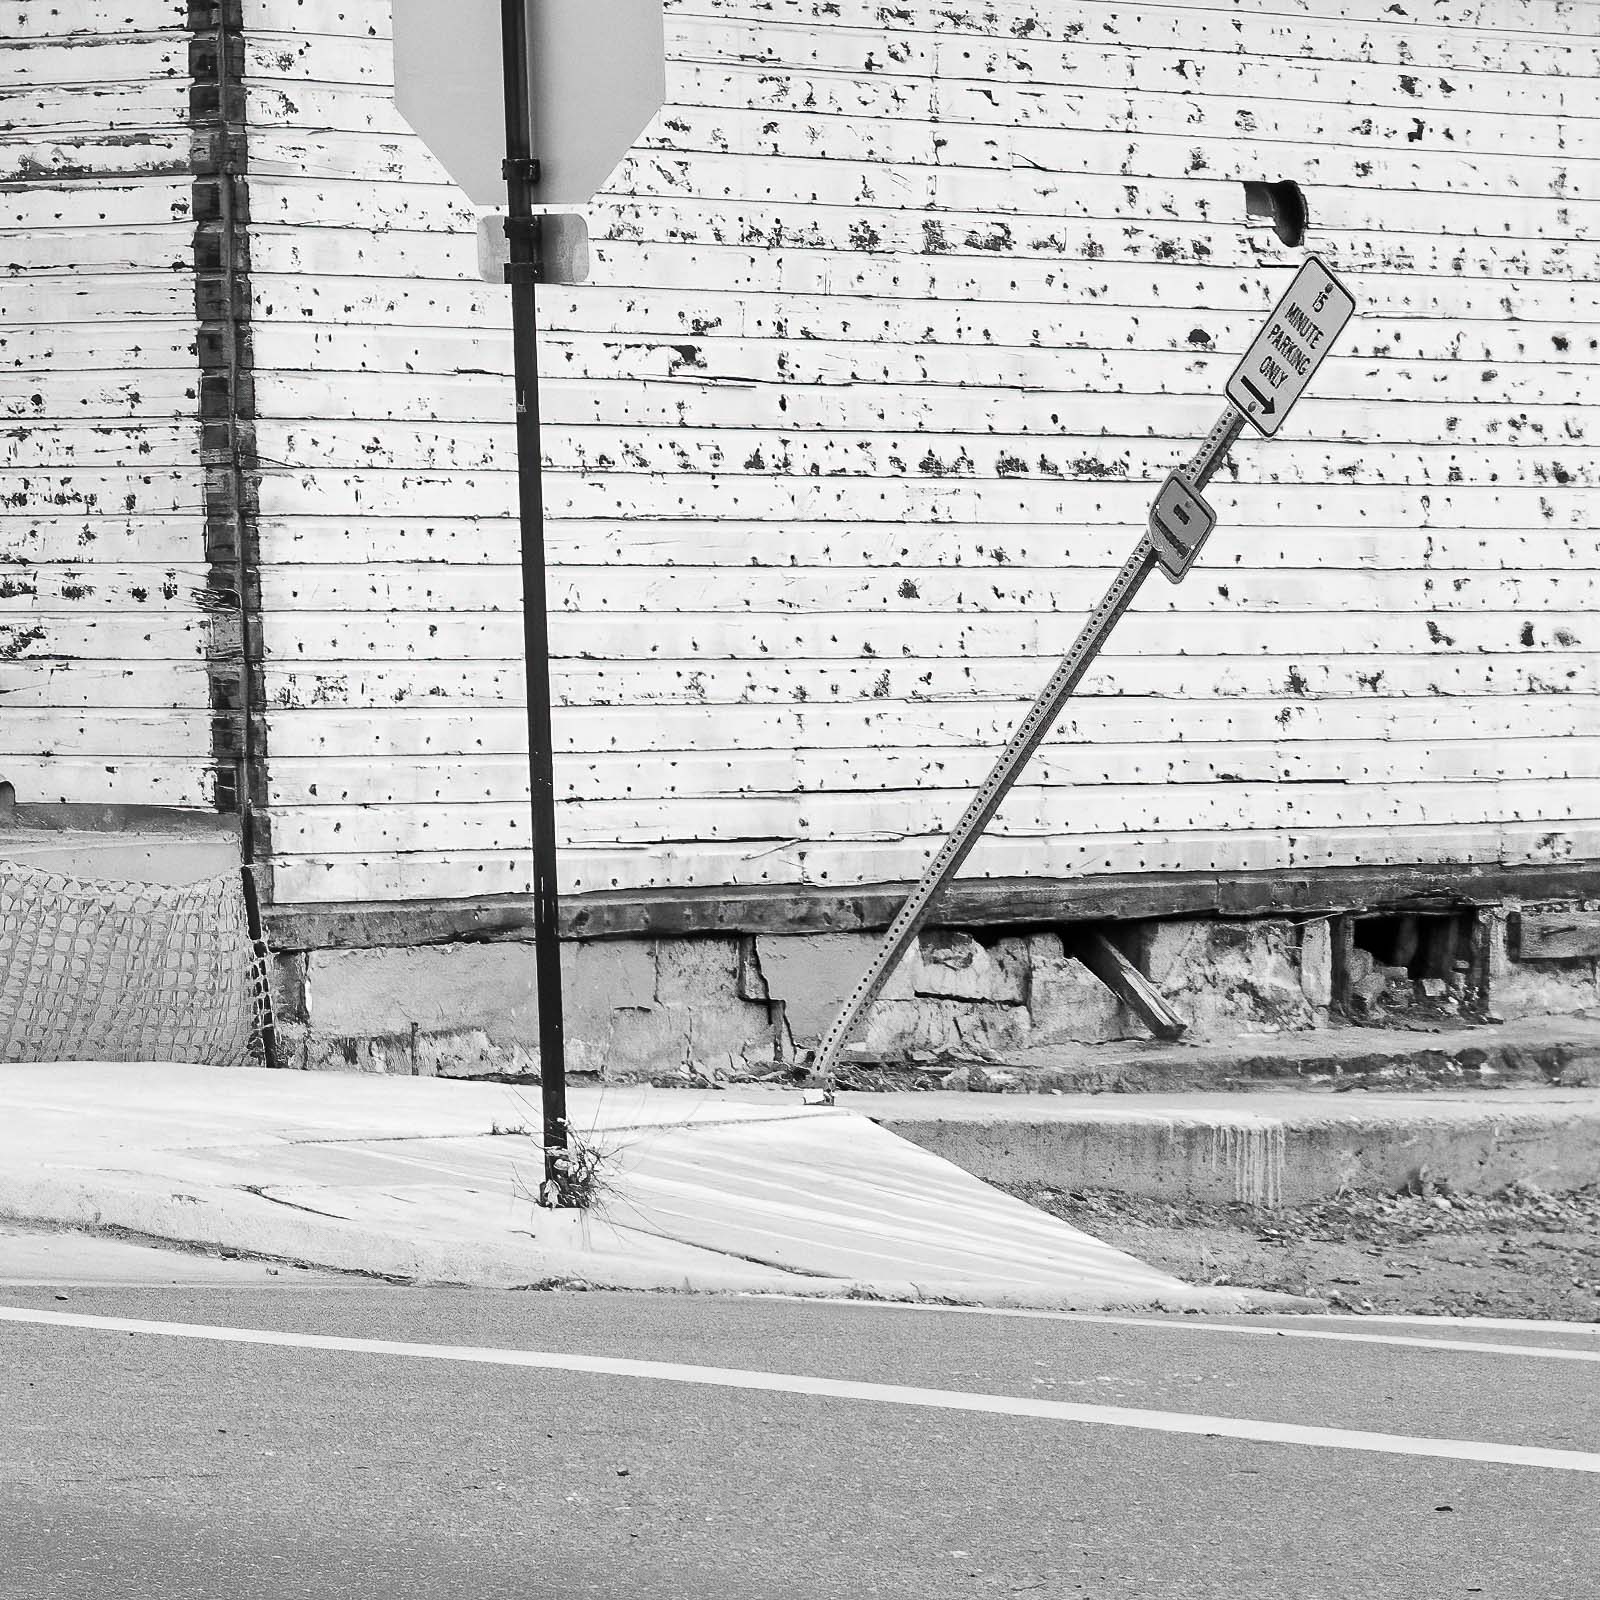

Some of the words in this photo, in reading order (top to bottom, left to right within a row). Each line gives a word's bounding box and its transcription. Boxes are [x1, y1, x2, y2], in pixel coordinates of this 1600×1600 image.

[1312, 291, 1328, 312] 15
[1285, 302, 1324, 349] MINUTE
[1267, 324, 1310, 376] PARKING
[1260, 356, 1288, 389] ONLY
